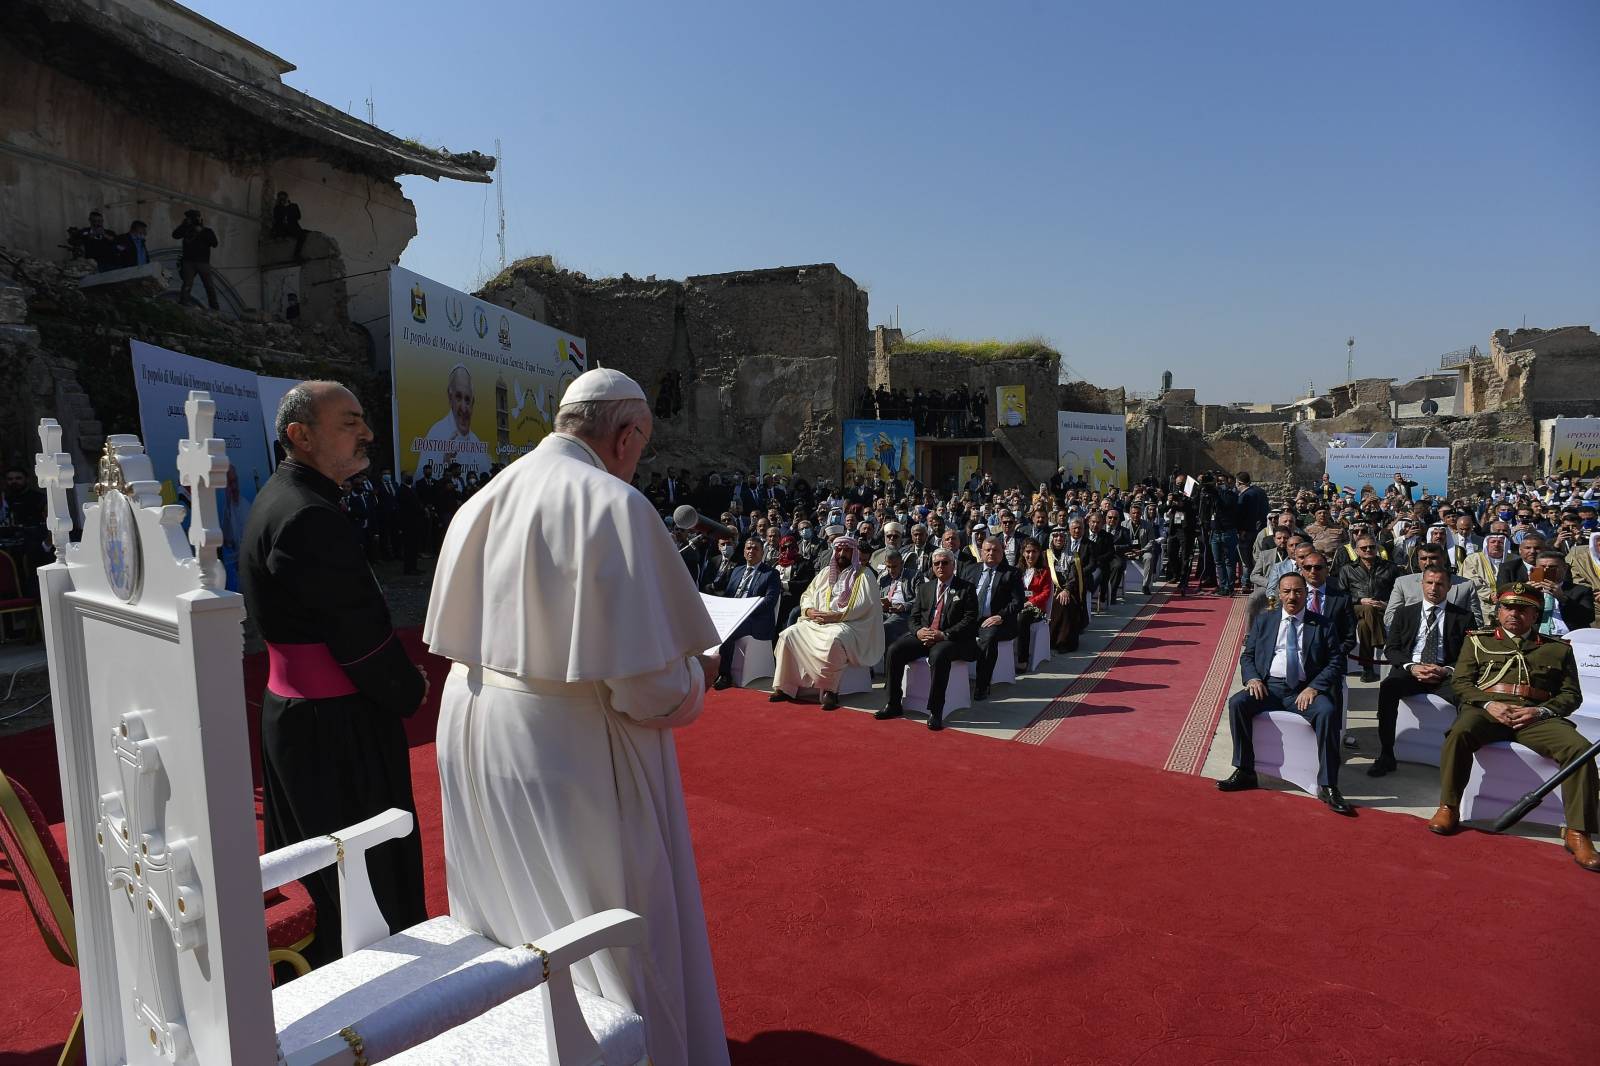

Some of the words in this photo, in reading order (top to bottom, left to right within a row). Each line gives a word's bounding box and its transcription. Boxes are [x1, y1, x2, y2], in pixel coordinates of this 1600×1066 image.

[410, 331, 431, 348] popolo
[440, 337, 457, 352] Mosul
[410, 437, 456, 452] APOSTOLIC
[456, 439, 489, 454] JOURNEY
